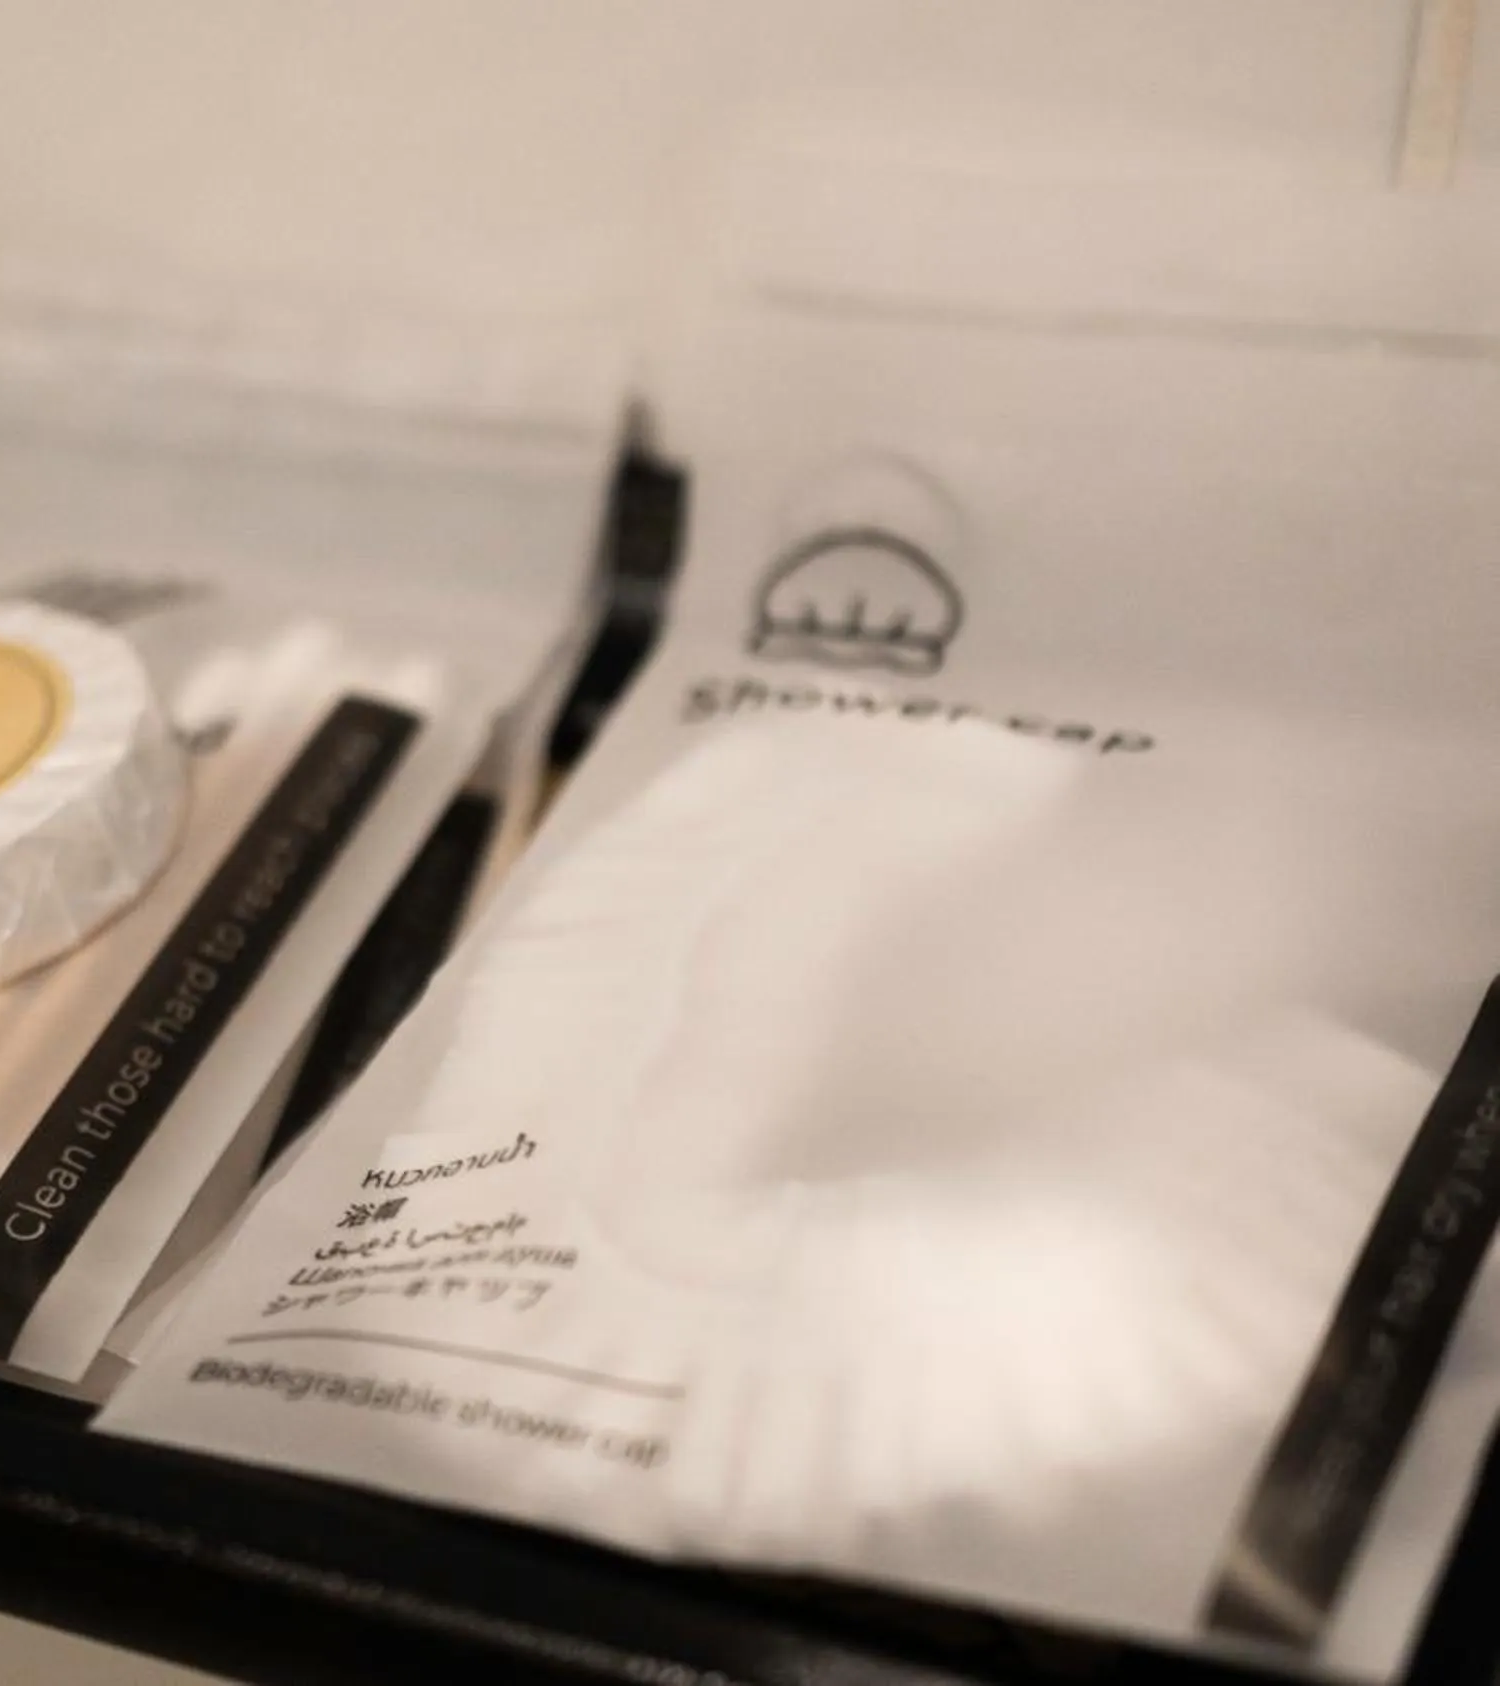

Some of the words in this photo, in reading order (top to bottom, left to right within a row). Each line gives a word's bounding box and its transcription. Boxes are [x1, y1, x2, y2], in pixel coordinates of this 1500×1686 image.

[4, 1139, 96, 1243] Clean
[76, 1046, 163, 1143] those
[146, 956, 218, 1045] hard
[199, 921, 247, 965] to
[188, 1357, 450, 1421] Biodegradable
[457, 1398, 591, 1451] shower
